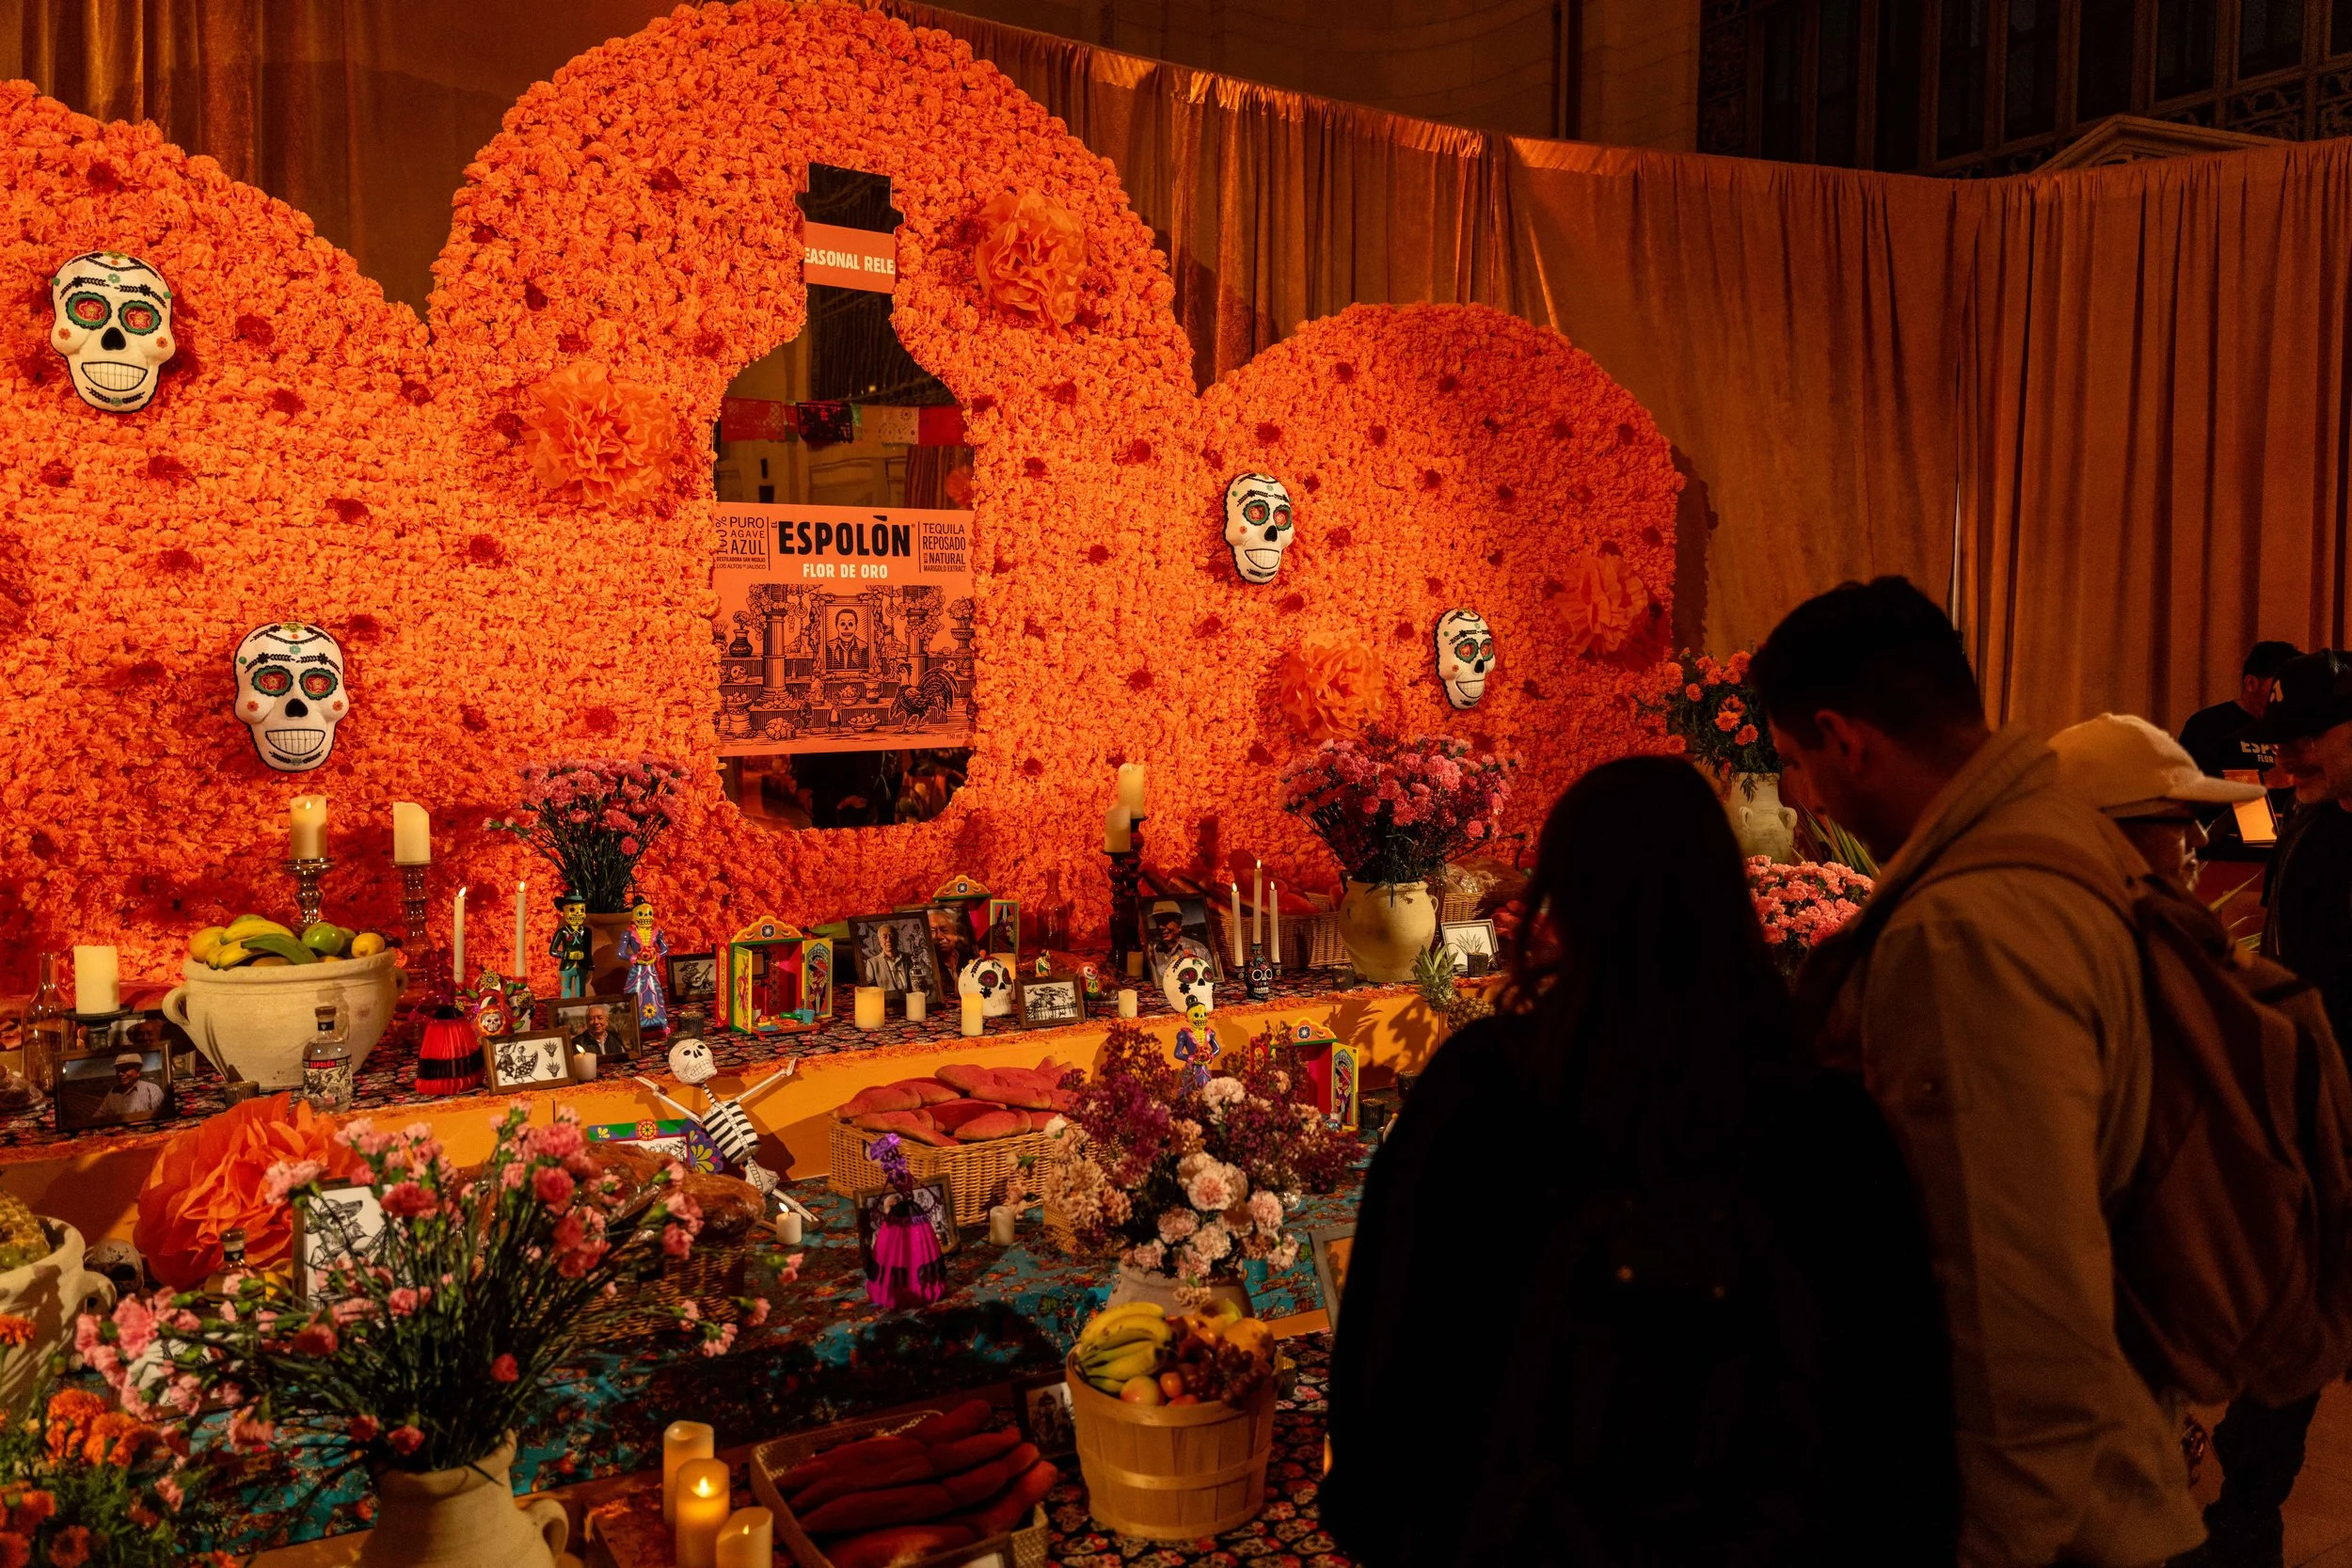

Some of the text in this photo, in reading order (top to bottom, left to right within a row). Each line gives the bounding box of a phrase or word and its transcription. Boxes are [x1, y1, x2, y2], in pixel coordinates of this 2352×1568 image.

[804, 247, 896, 275] EASONAL RELE
[730, 516, 764, 529] PURO
[923, 523, 965, 534] TEQUILA
[731, 530, 765, 538] AGAVE
[731, 539, 766, 555] AZUL
[923, 536, 965, 550] REPOSADO
[929, 553, 966, 564] NATURAL
[803, 563, 888, 578] FLOR DE ORO
[2257, 754, 2274, 763] FLOR
